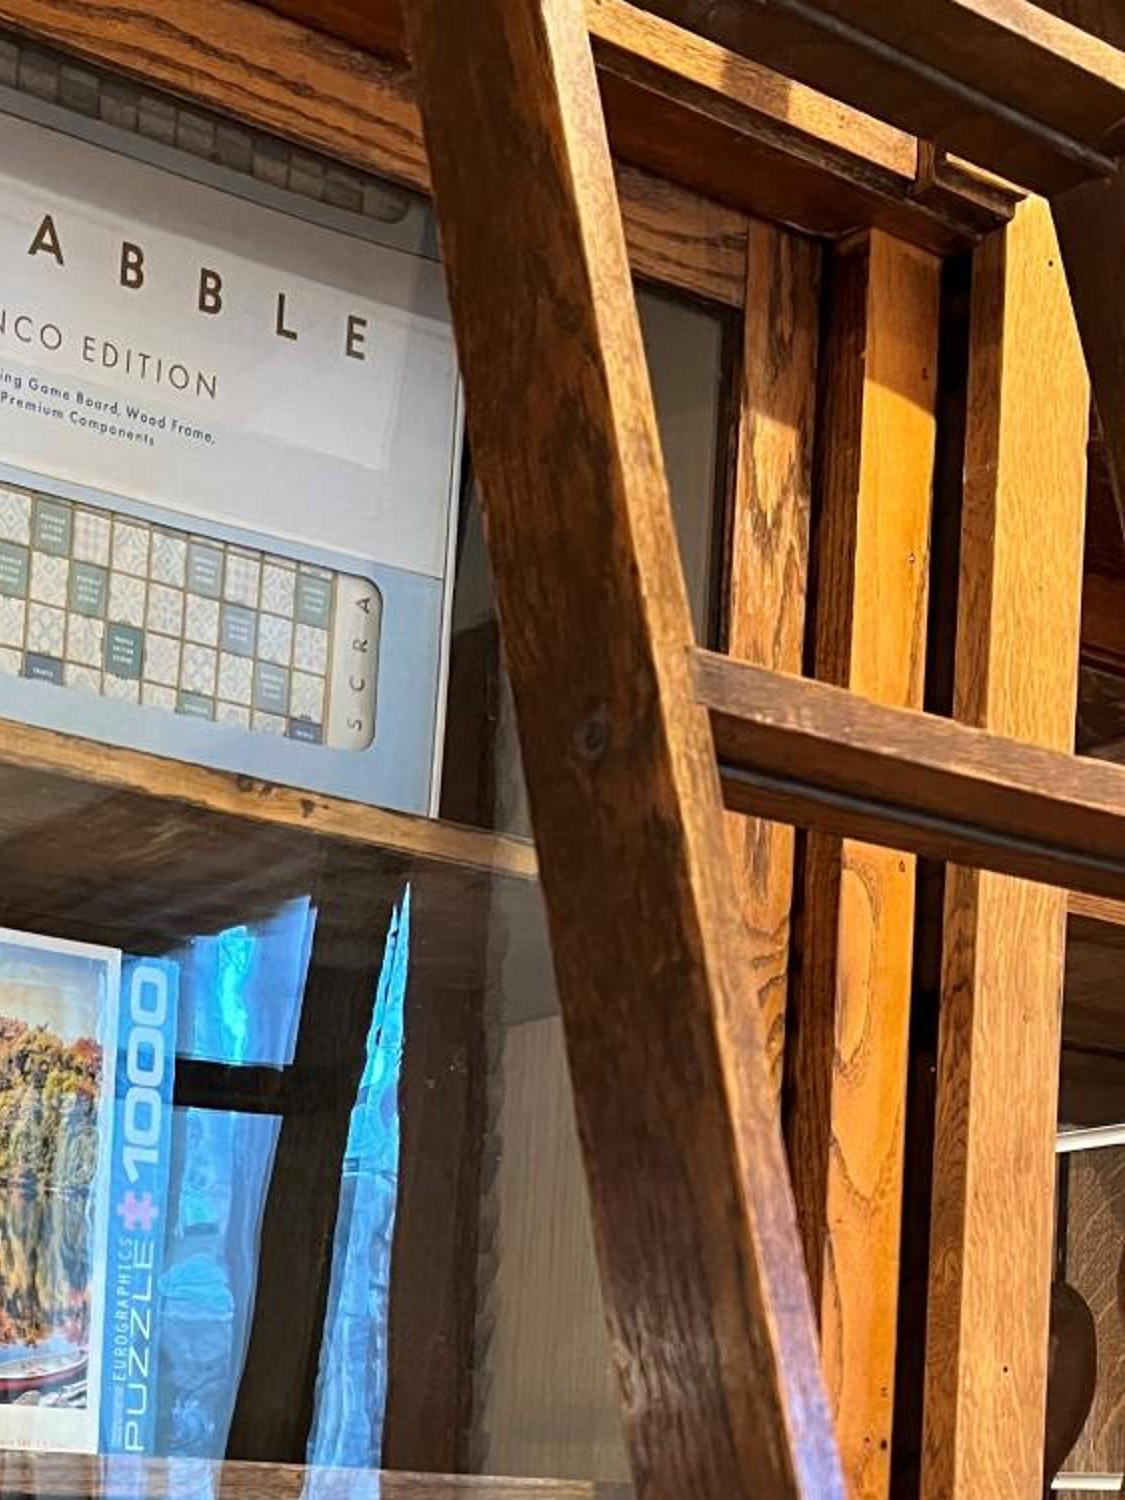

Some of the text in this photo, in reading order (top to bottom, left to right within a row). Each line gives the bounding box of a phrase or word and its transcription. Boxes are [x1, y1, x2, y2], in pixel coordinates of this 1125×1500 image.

[0, 391, 64, 420] Premium
[70, 410, 155, 446] Components
[28, 377, 70, 401] Game
[76, 391, 121, 418] Board,
[126, 405, 167, 430] Wood
[171, 420, 216, 446] Frame,
[83, 335, 218, 400] EDITION
[124, 966, 169, 1184] 1000
[112, 1235, 134, 1382] EUROGRAPHICS
[125, 1240, 156, 1452] PUZZLE
